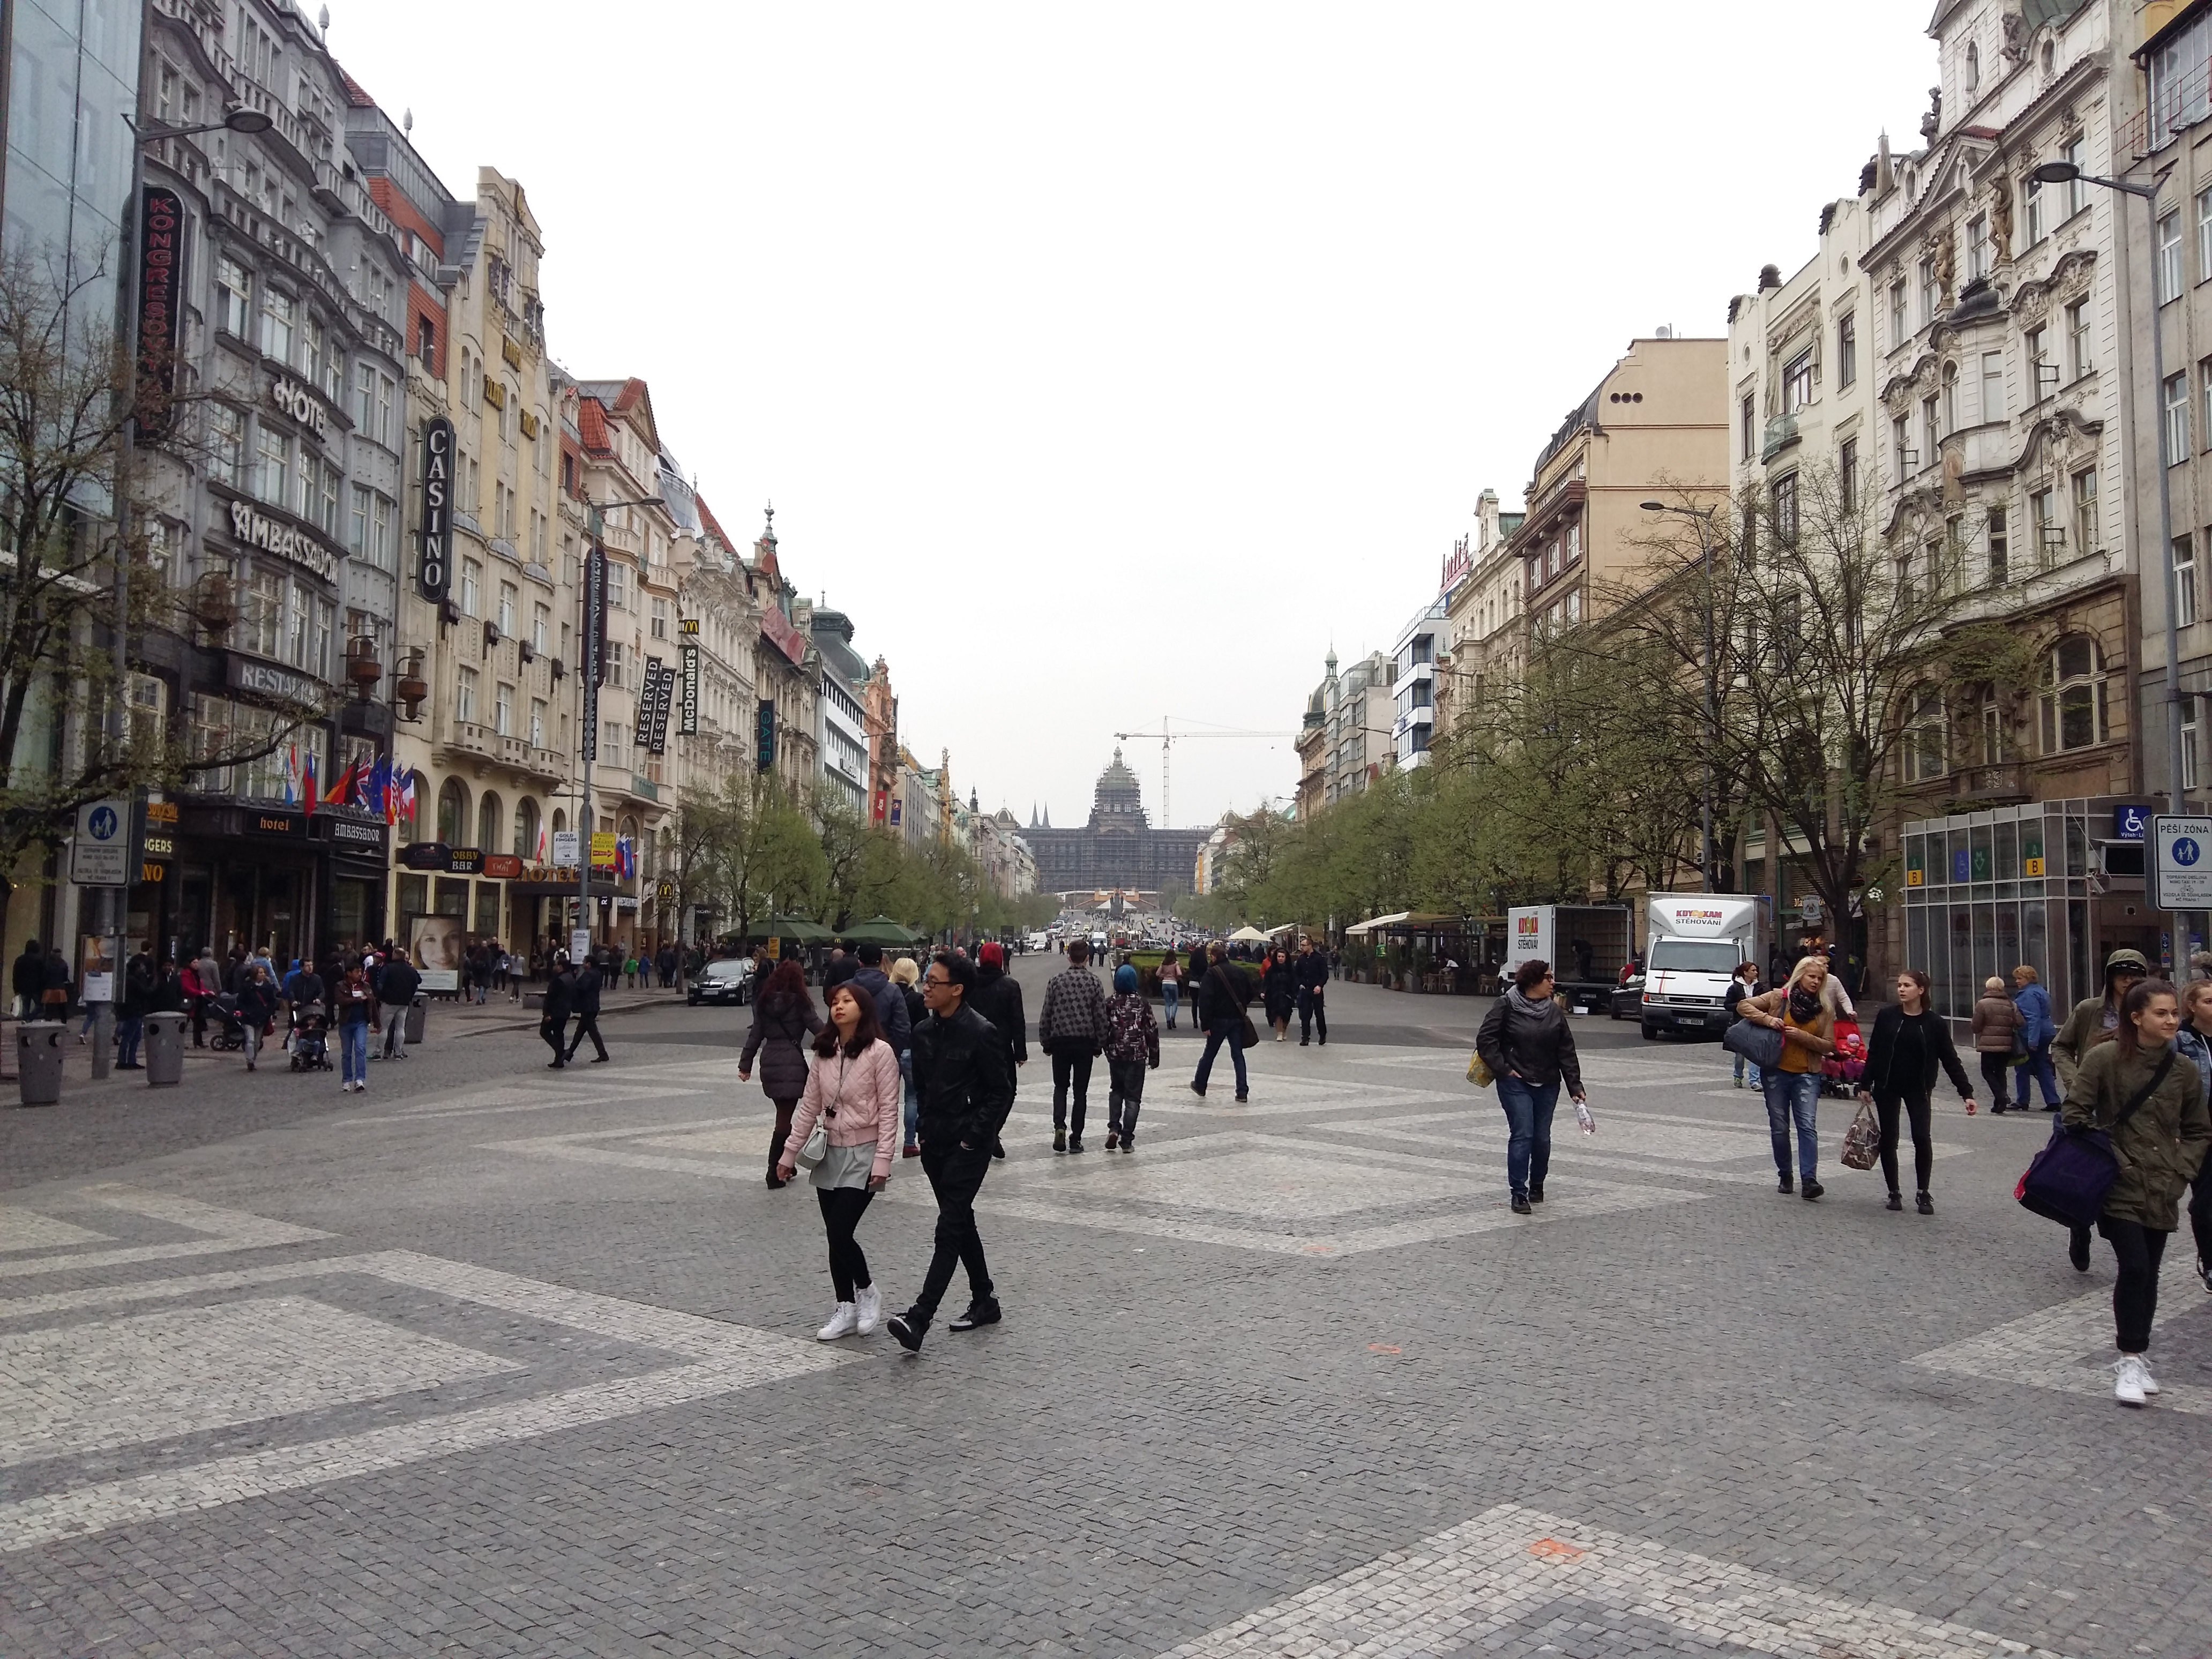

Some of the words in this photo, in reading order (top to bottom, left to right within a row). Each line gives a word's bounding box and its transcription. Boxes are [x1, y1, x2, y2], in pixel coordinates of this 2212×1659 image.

[424, 430, 446, 586] CASINO
[231, 500, 339, 587] AMBASSADOR
[684, 648, 696, 731] McDonald's
[638, 661, 658, 742] RESERVED
[653, 672, 672, 750] RESERVED
[760, 711, 772, 761] GATE
[260, 817, 289, 831] hotel
[335, 823, 380, 842] AMBASSADOR
[2161, 824, 2181, 833] PĚŠÍ
[2184, 824, 2209, 834] ZÓNA
[453, 851, 479, 860] OBBY
[141, 863, 163, 882] NO
[452, 861, 473, 870] BAR
[2032, 861, 2038, 873] B
[1912, 872, 1917, 883] B
